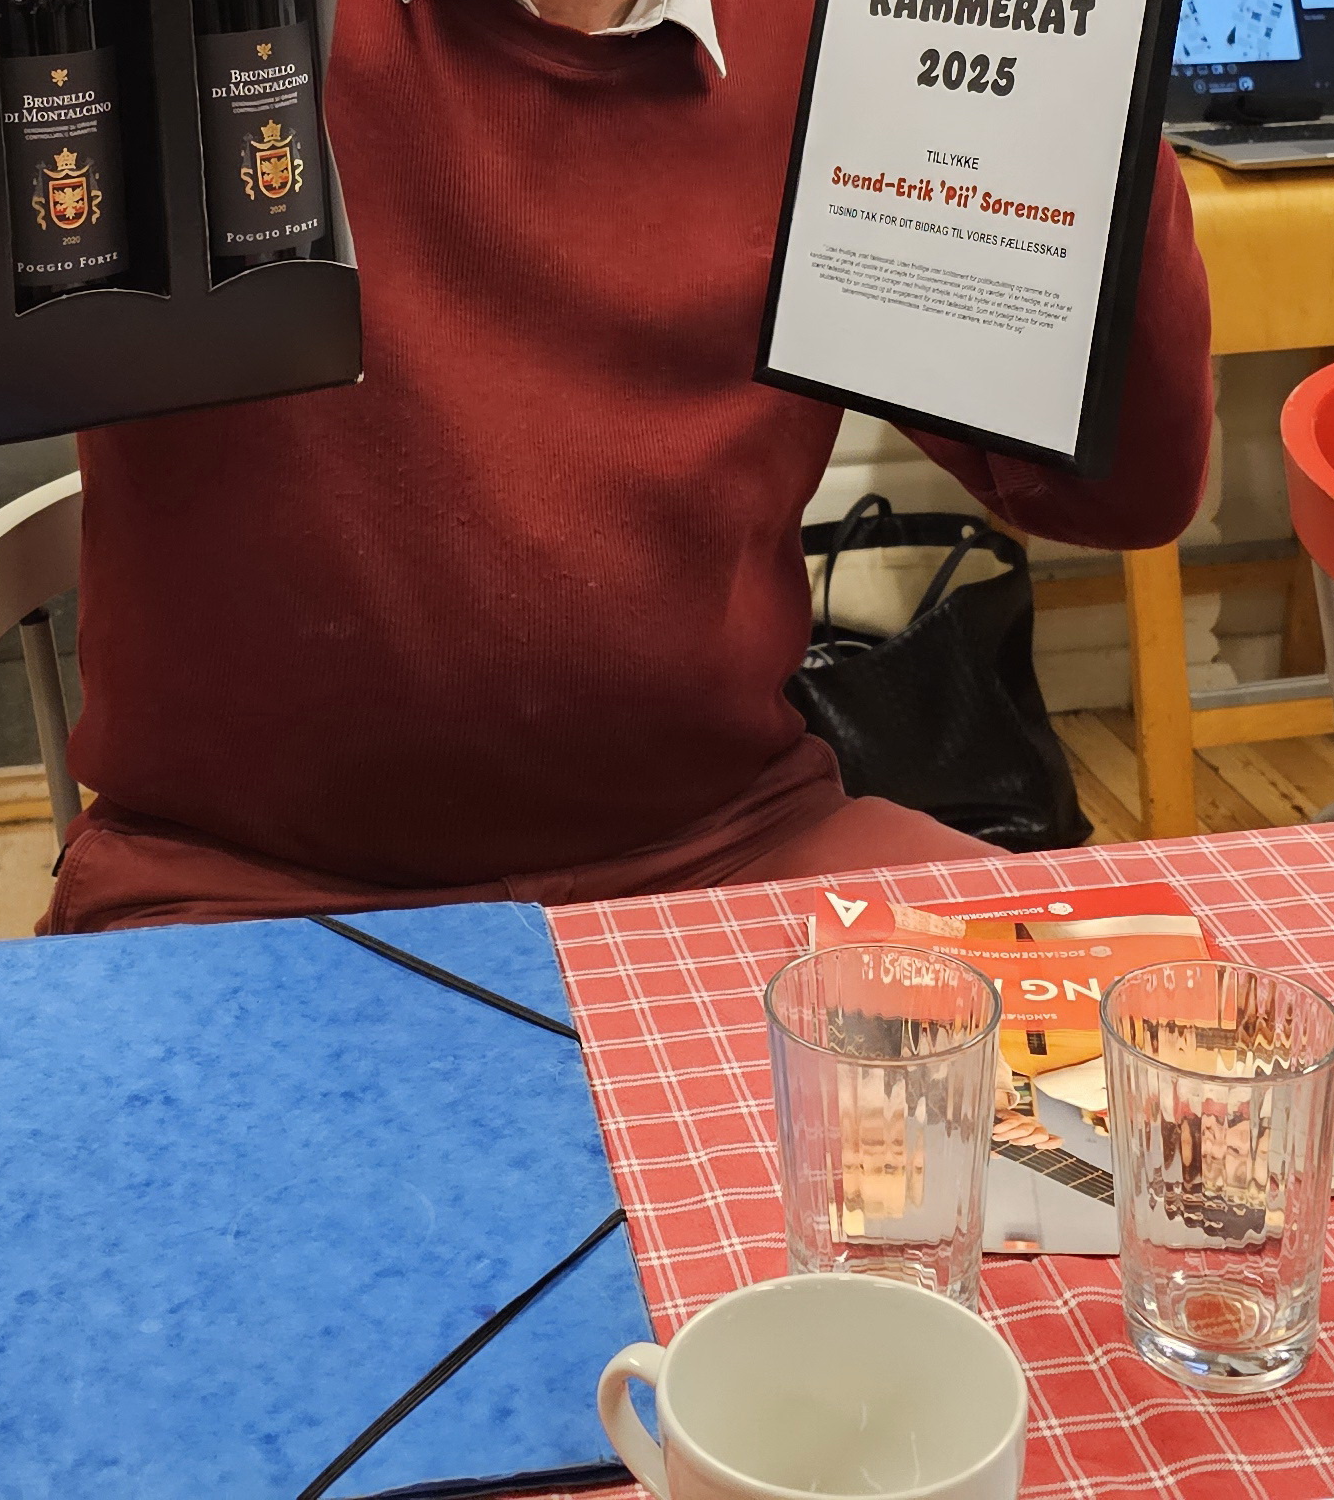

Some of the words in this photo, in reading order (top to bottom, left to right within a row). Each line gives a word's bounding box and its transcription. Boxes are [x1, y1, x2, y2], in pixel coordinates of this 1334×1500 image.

[230, 64, 295, 83] BRUNELLO
[916, 48, 1018, 97] 2025
[211, 88, 226, 98] DI
[229, 73, 309, 97] MONTALCINO
[23, 91, 95, 109] BRUNELLO
[4, 113, 19, 123] DI
[22, 101, 112, 123] MONTALCINO
[927, 149, 979, 170] TILLYKKE
[832, 165, 934, 202] Svend-Erik
[980, 191, 1075, 227] Sørensen
[269, 204, 287, 214] 2020
[62, 236, 81, 246] 2020
[226, 229, 280, 243] POGGIO
[285, 218, 318, 236] FORTE
[828, 203, 858, 218] TUSIND
[860, 210, 877, 223] TAK
[879, 213, 897, 226] FOR
[899, 218, 914, 229] DIT
[915, 221, 949, 236] BIDRAG
[951, 227, 964, 240] TIL
[967, 230, 998, 246] VORES
[1000, 236, 1067, 259] FÆLLESSKAB
[17, 261, 73, 273] POGGIO
[79, 251, 118, 269] FORTE
[825, 891, 868, 928] A
[932, 945, 1086, 959] SOCIALDEMOKRATERNE
[1020, 977, 1103, 1001] NG
